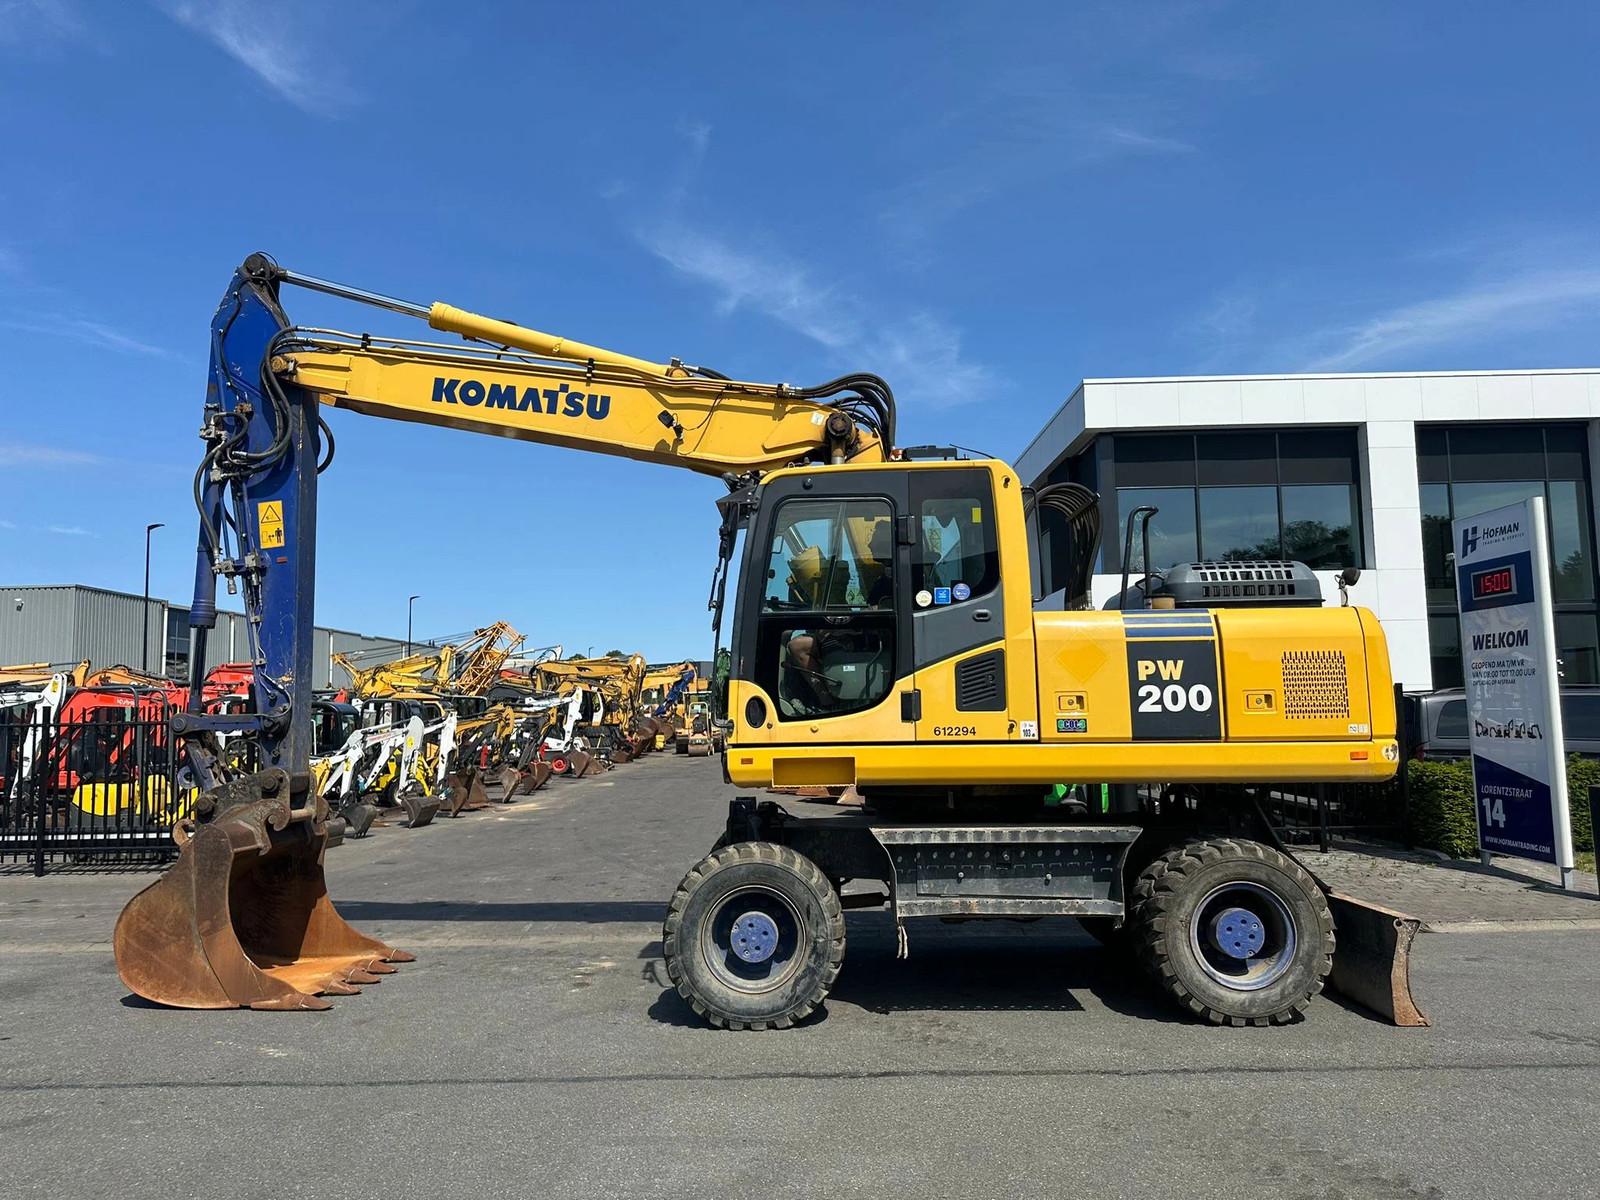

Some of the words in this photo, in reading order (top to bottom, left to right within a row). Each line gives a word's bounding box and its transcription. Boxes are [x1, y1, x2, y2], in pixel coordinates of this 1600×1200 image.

[432, 377, 611, 420] KOMATSU
[1482, 522, 1519, 541] HOFMAN
[1472, 629, 1529, 651] WELKOM
[1137, 660, 1184, 680] PW
[1471, 660, 1496, 670] GEOPEND
[1499, 669, 1510, 677] TOT
[1138, 684, 1212, 712] 200
[933, 726, 976, 736] 612294
[1481, 785, 1533, 798] LORENTZSTRAAT
[1482, 798, 1506, 828] 14
